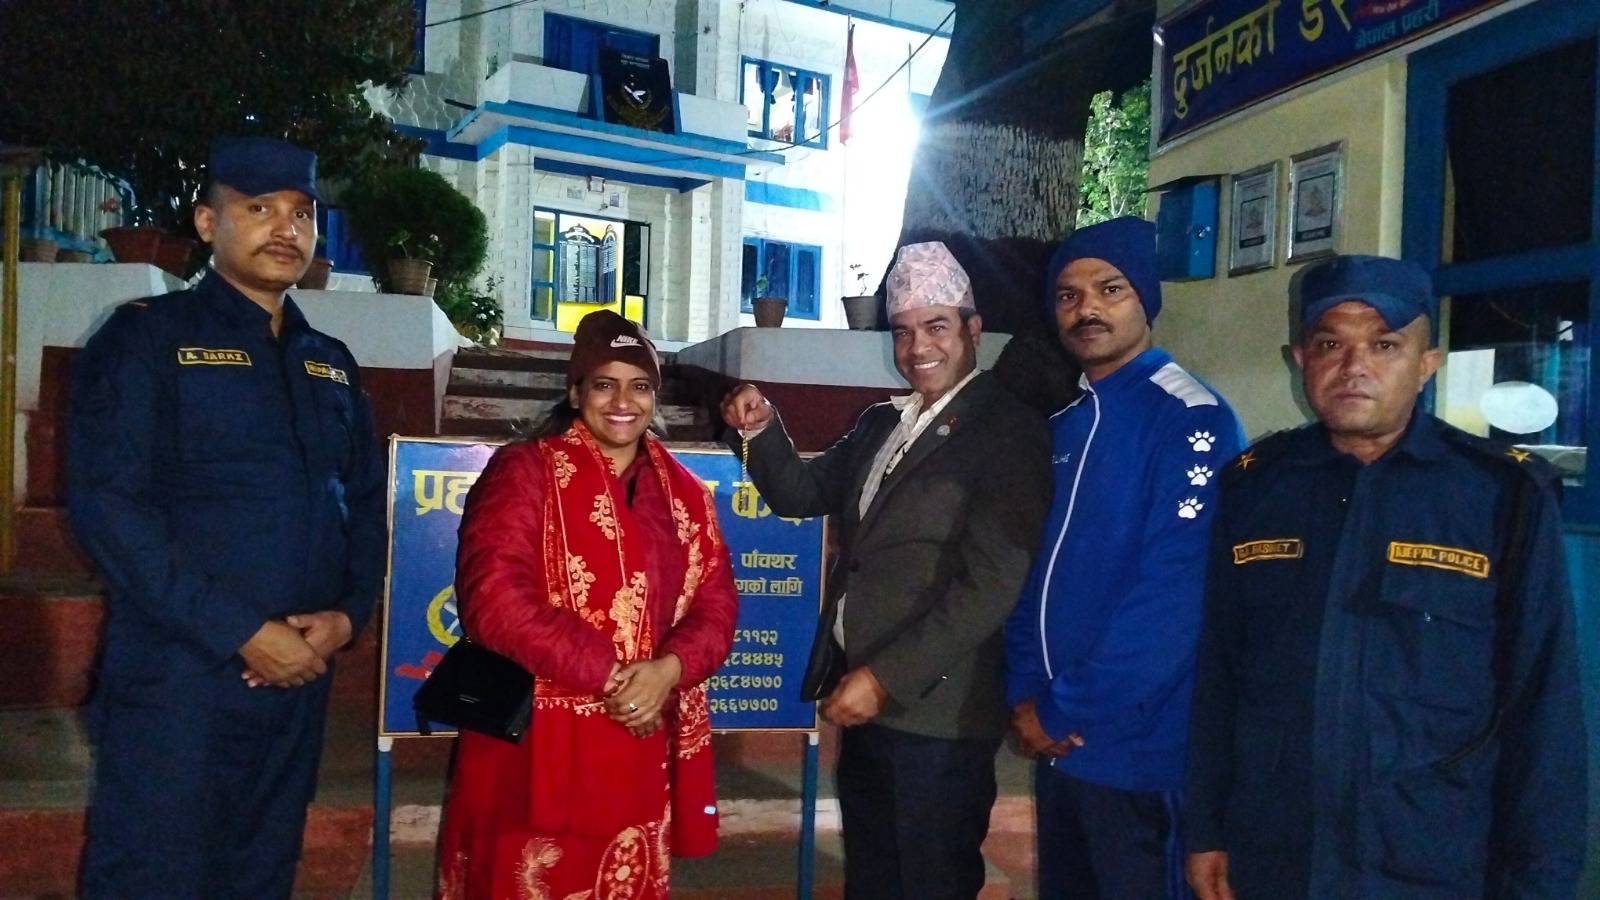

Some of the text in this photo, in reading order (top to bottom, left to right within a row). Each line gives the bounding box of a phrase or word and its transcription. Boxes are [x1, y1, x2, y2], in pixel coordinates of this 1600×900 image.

[616, 334, 638, 344] NIKE
[412, 469, 481, 516] प्रह
[741, 549, 798, 570] पाँचथर
[1395, 546, 1481, 570] NEPAL POLICE
[734, 576, 803, 595] गको लागि
[733, 629, 778, 645] ८११२२
[723, 652, 783, 668] ८४४४५
[702, 675, 782, 691] २६८४७७०
[709, 698, 778, 714] २६६७७००
